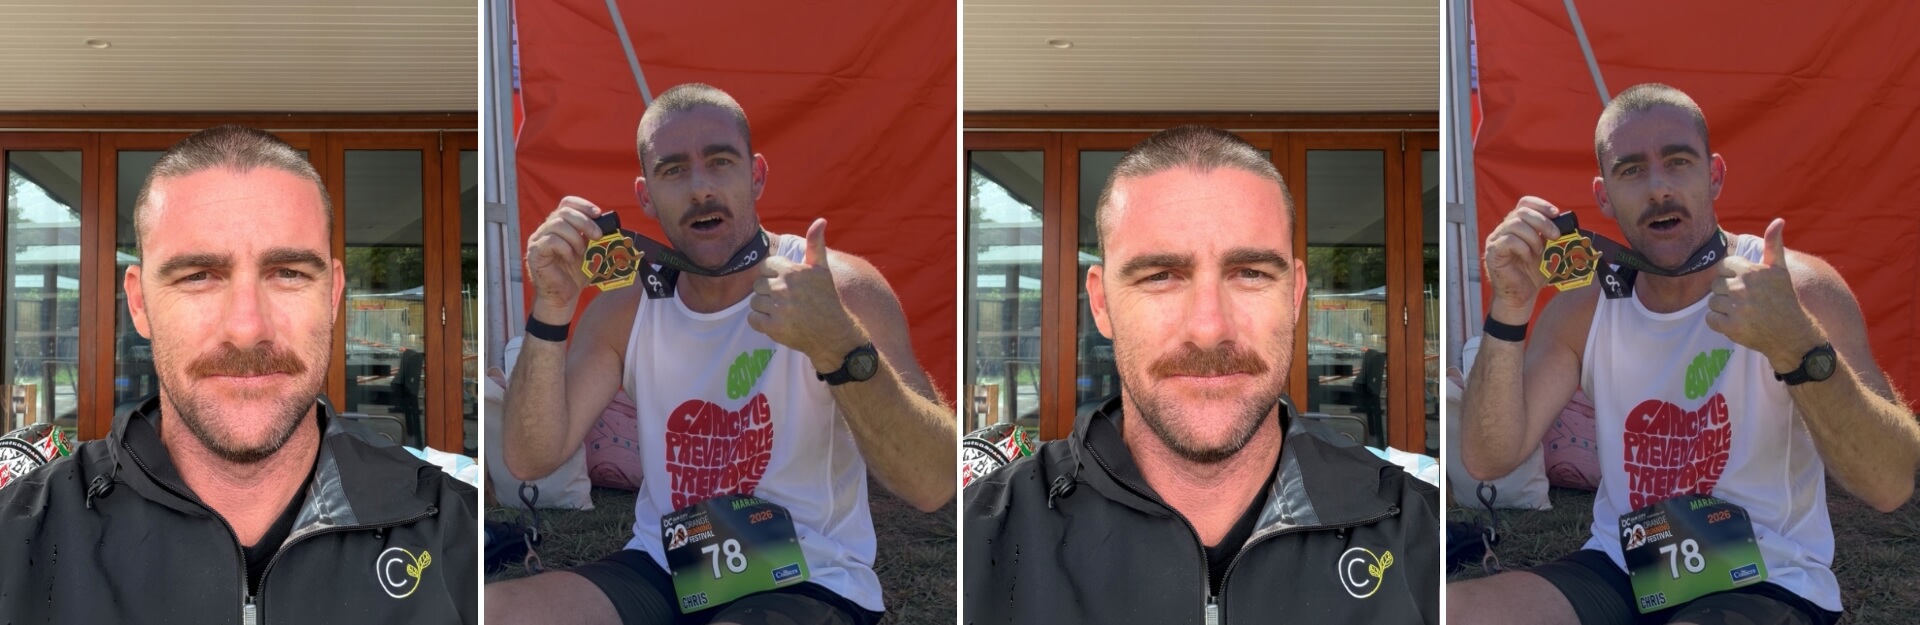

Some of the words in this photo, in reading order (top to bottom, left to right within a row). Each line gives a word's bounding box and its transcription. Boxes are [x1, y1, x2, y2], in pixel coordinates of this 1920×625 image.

[685, 515, 710, 529] ORANGE
[749, 510, 773, 524] 2026
[1643, 515, 1668, 529] ORANGE
[1707, 510, 1731, 524] 2026
[665, 524, 688, 551] 20
[689, 530, 715, 544] FESTIVAL
[1623, 524, 1646, 551] 20
[1647, 530, 1673, 544] FESTIVAL
[701, 538, 748, 580] 78
[1659, 538, 1706, 580] 78
[775, 568, 798, 579] Colliers
[1733, 568, 1756, 579] Colliers
[682, 592, 709, 609] CHRIS
[1640, 592, 1667, 609] CHRIS
